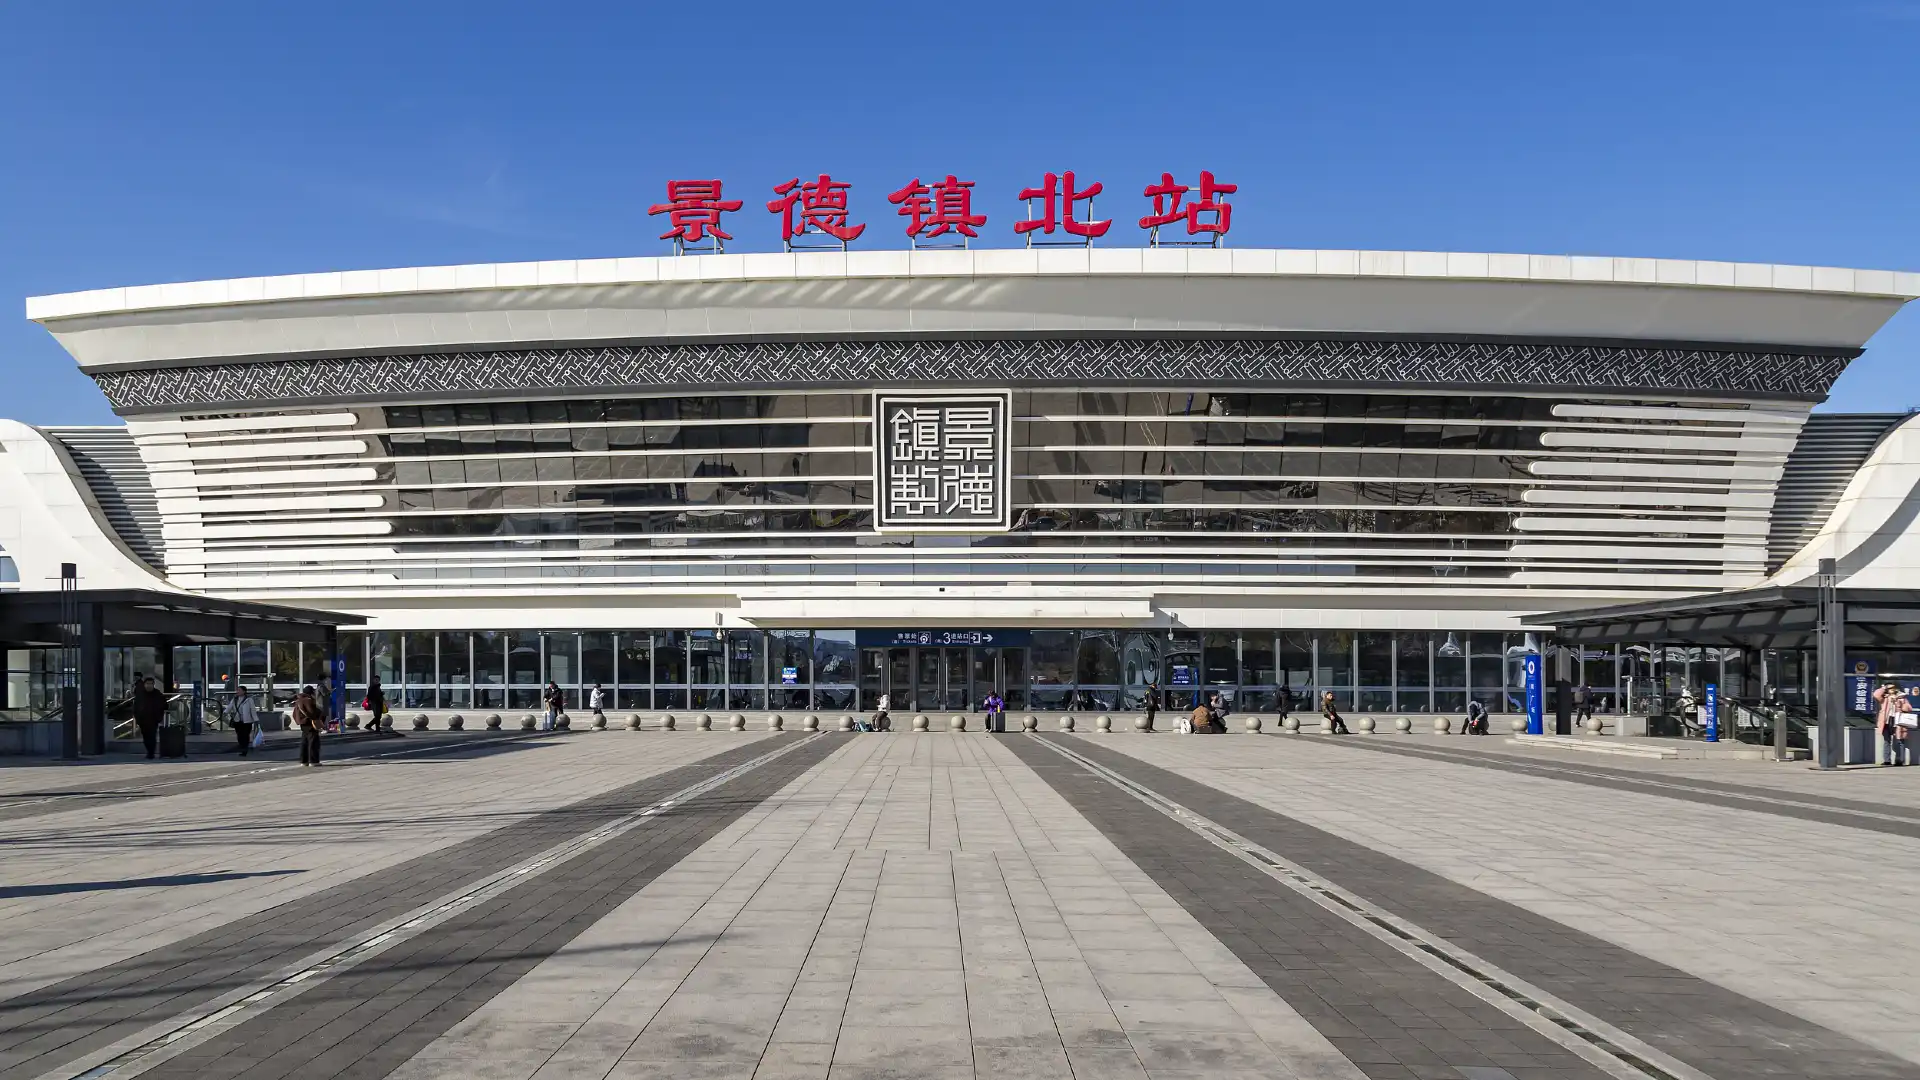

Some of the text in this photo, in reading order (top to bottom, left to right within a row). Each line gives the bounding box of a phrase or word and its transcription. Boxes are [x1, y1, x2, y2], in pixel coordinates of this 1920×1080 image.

[647, 169, 1239, 243] 景德镇北站
[943, 632, 951, 644] 3
